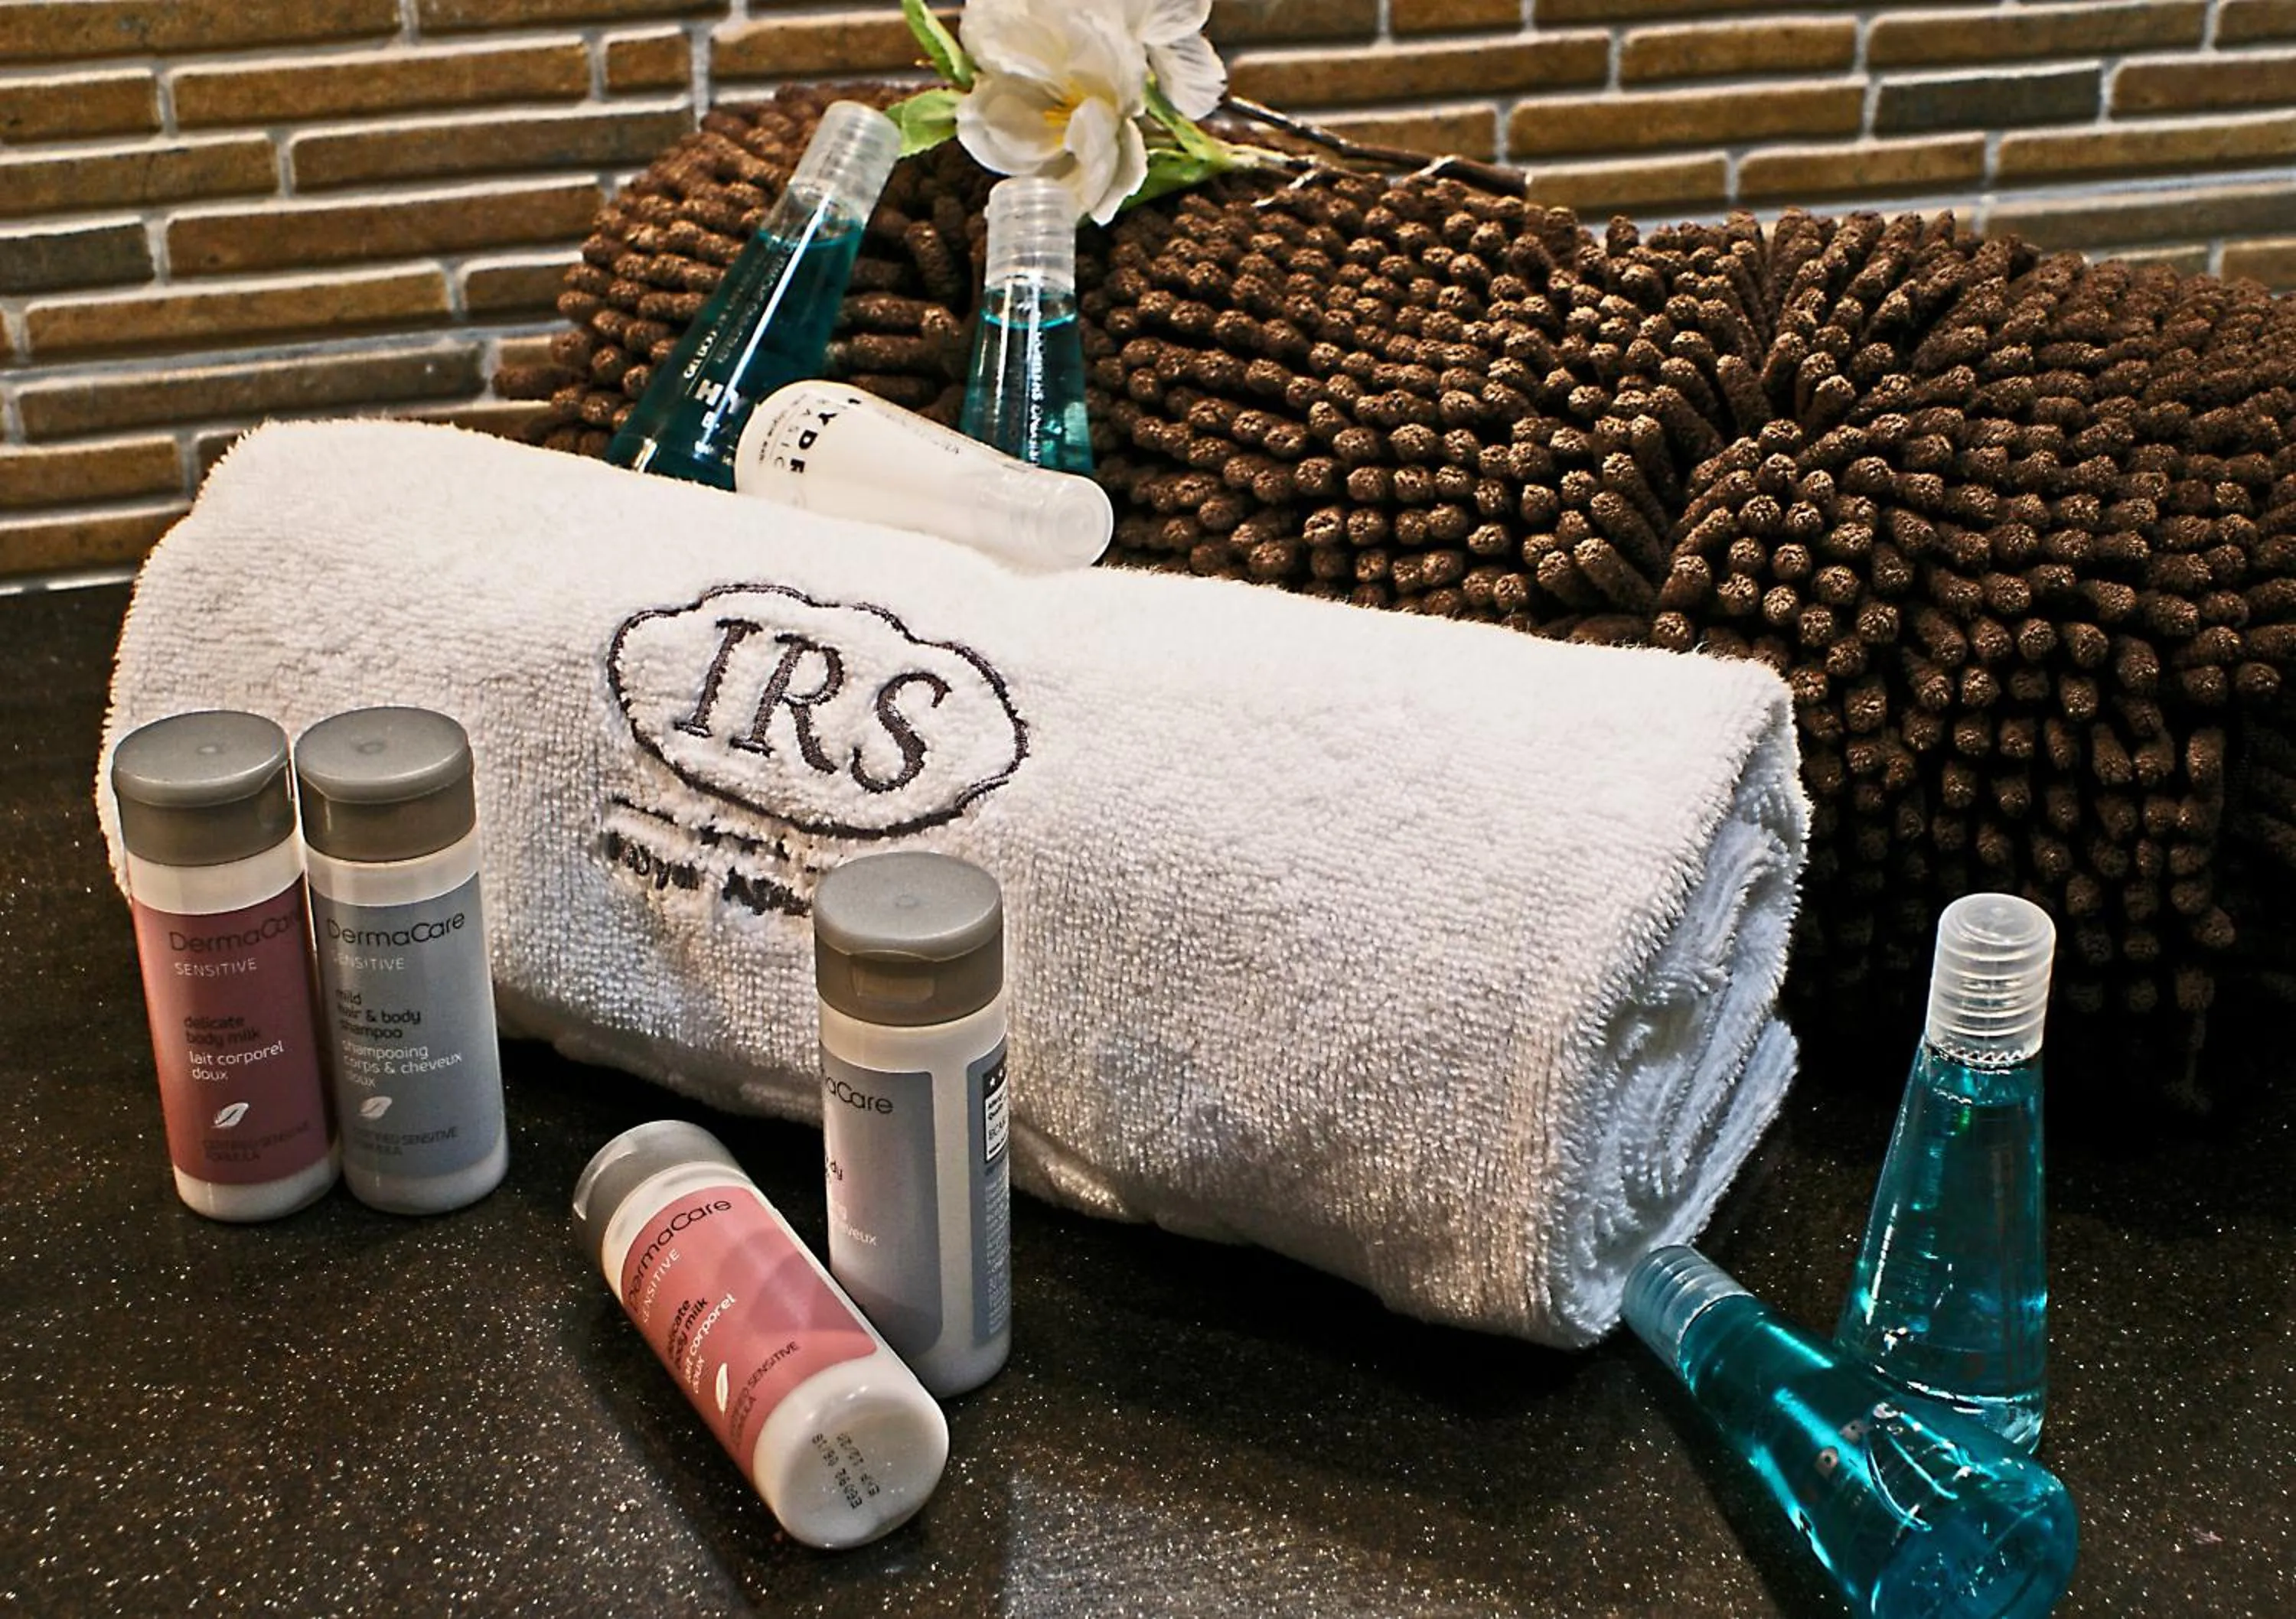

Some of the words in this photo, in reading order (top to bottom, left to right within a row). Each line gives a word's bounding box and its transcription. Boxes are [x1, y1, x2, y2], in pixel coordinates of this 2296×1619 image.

[673, 617, 953, 794] IRS
[327, 911, 465, 947] DermaCare
[173, 956, 258, 979] SENSITIVE
[365, 1008, 378, 1023] &
[380, 1008, 422, 1025] body
[188, 1050, 214, 1066] lait
[217, 1039, 285, 1066] corporel
[383, 1060, 396, 1074] &
[400, 1051, 463, 1074] cheveux
[191, 1067, 230, 1082] doux
[684, 1297, 709, 1331] milk
[690, 1292, 736, 1357] corporel
